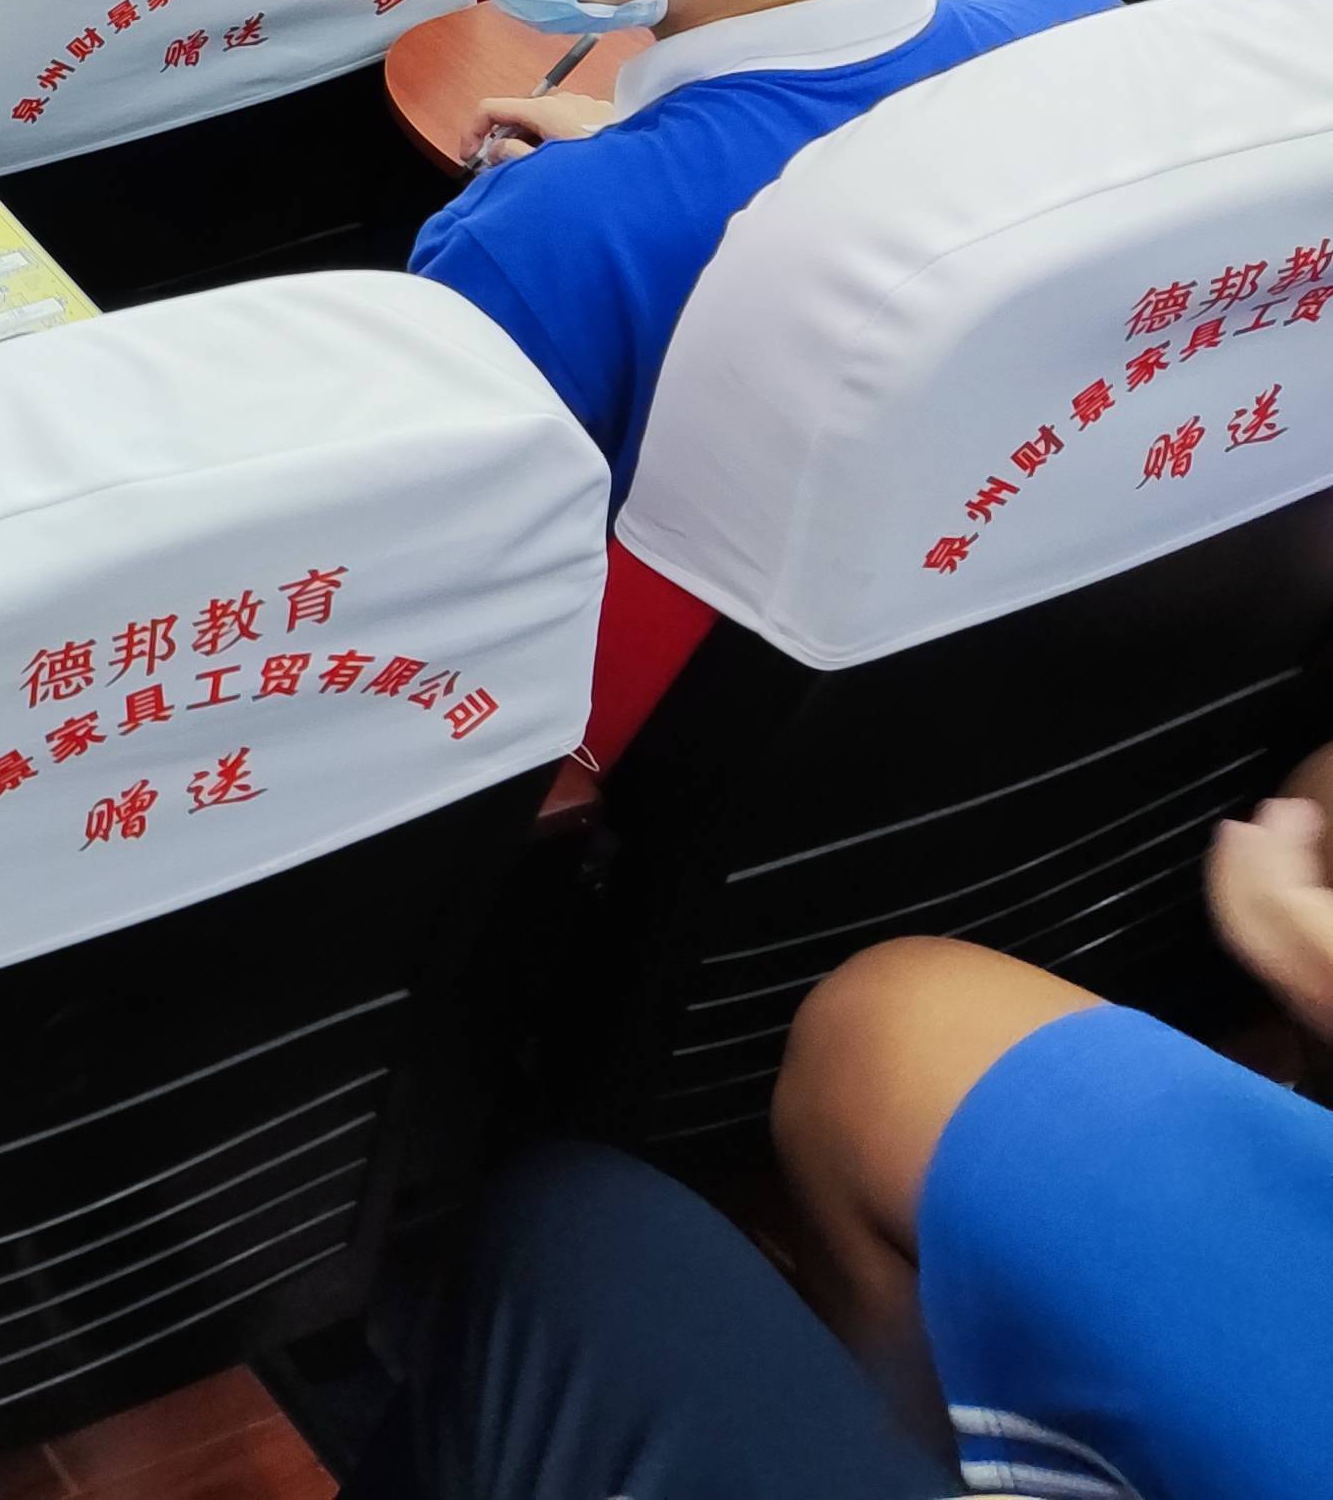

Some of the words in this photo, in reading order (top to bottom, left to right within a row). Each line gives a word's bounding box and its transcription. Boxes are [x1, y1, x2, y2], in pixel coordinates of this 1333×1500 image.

[160, 12, 270, 74] 赠送
[1136, 384, 1290, 490] 赠送
[18, 565, 350, 708] 德邦教育
[78, 746, 270, 851] 赠送
